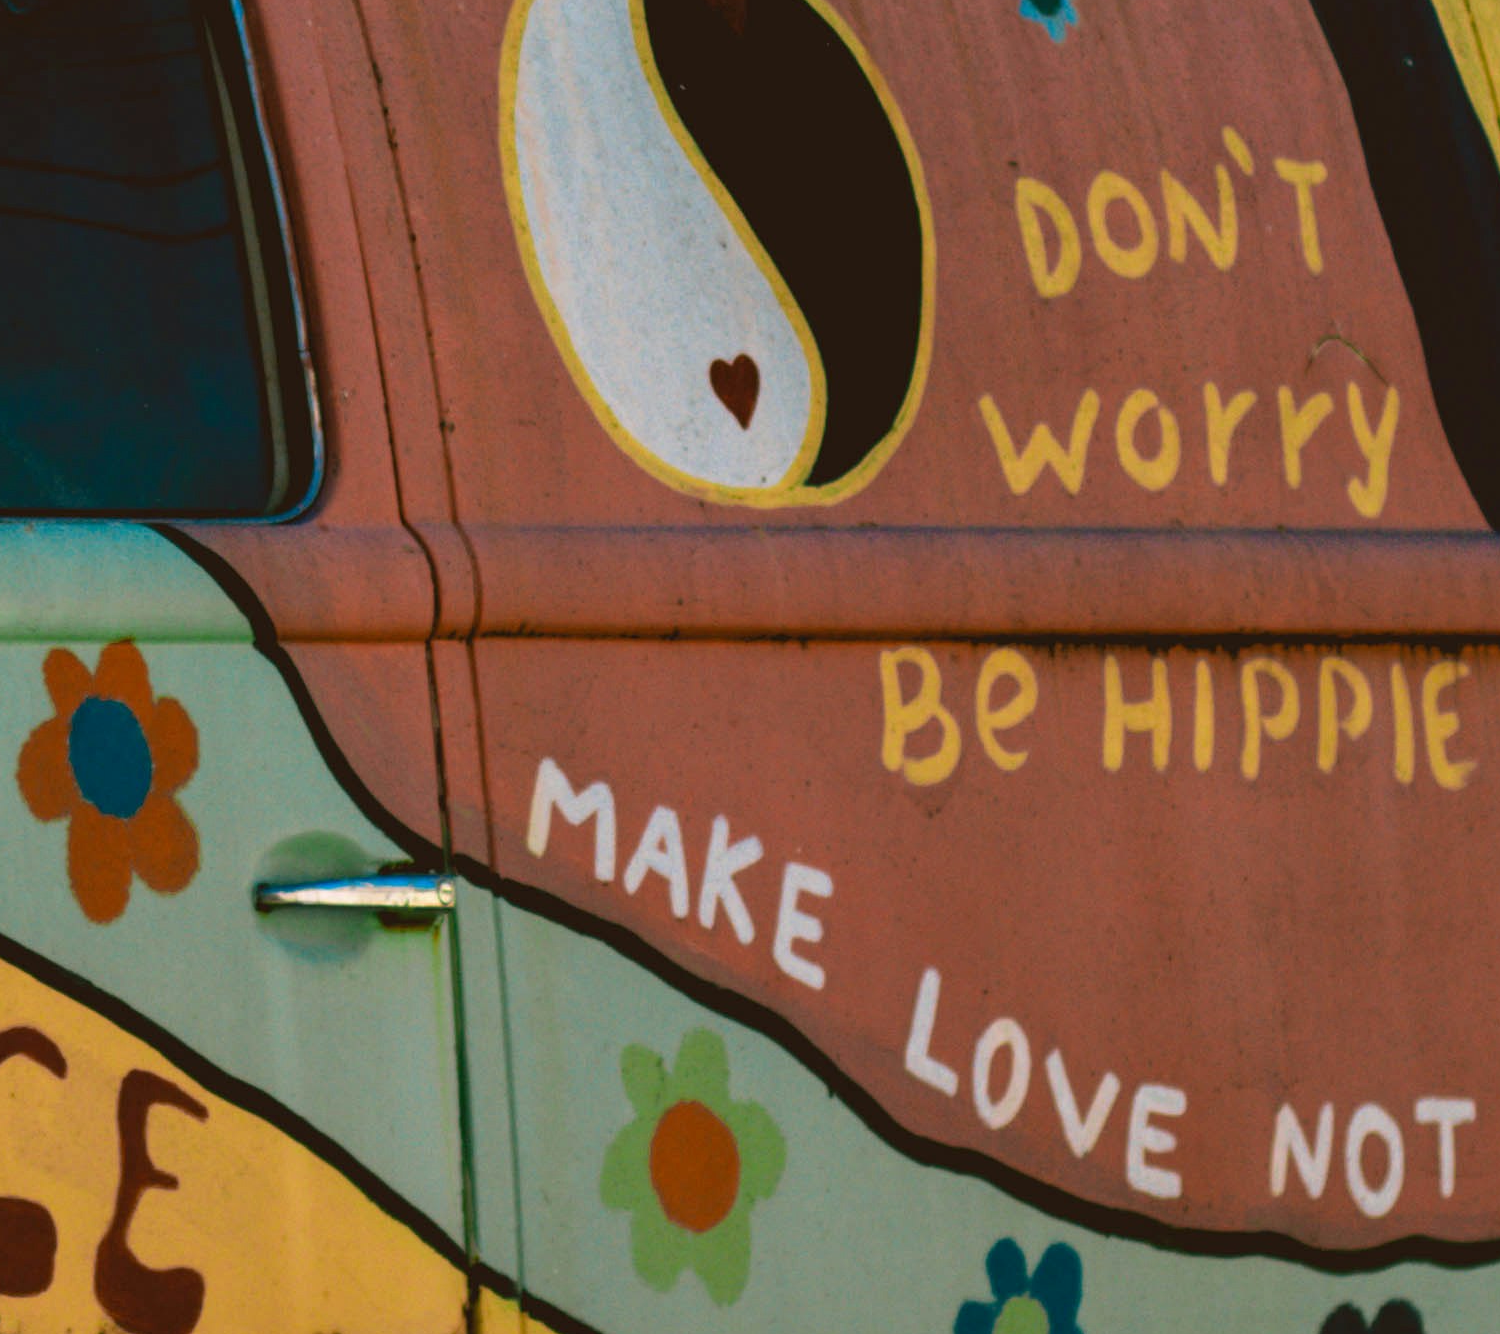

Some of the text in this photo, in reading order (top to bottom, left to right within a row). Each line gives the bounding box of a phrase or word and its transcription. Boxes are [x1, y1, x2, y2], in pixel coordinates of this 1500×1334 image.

[1016, 126, 1328, 298] DON'T
[880, 647, 1477, 789] Be HIPPIE
[527, 758, 834, 989] MAKE
[905, 968, 1187, 1199] LOVE
[1270, 1099, 1476, 1218] NOT
